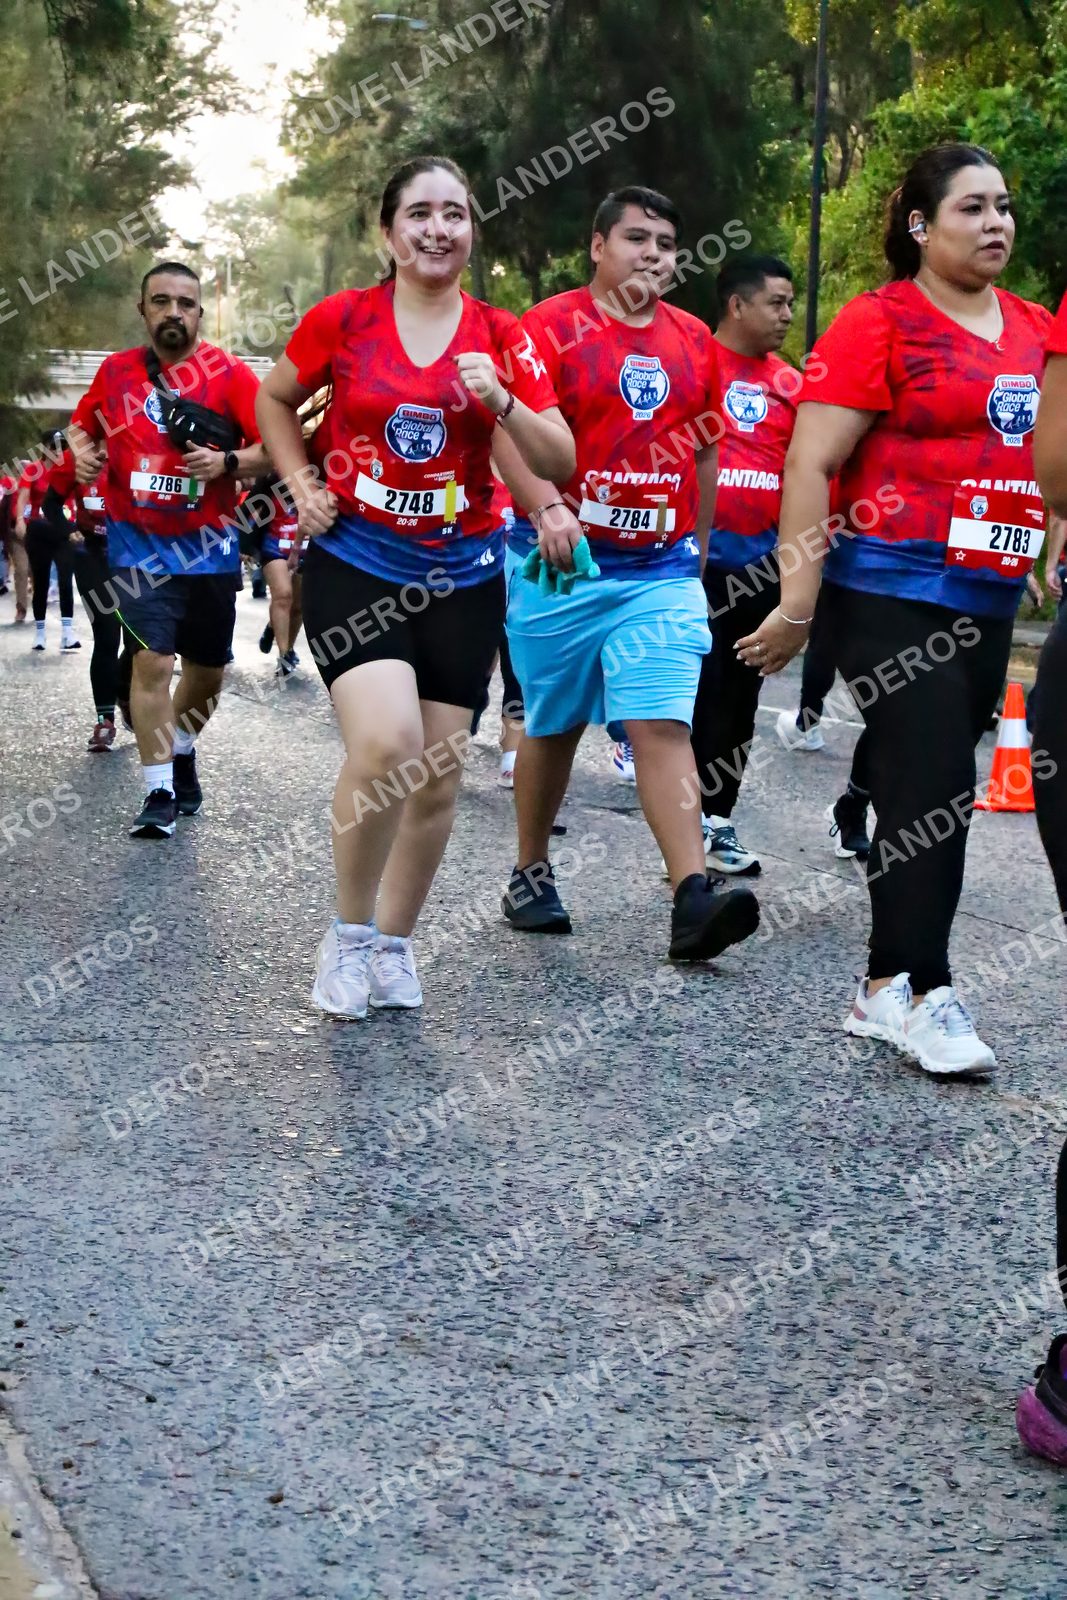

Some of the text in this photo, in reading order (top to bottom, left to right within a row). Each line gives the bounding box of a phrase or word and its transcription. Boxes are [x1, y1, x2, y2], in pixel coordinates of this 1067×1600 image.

[629, 360, 656, 369] BIMBO
[631, 370, 657, 380] Global
[627, 379, 647, 389] Race
[1001, 380, 1032, 388] BIMBO
[1002, 392, 1032, 403] Global
[996, 401, 1021, 412] Race
[402, 410, 438, 421] BIMBO
[401, 420, 434, 433] Global
[394, 428, 420, 440] Race
[150, 475, 182, 492] 2786
[717, 468, 779, 491] ANTIAGO
[384, 489, 434, 514] 2748
[396, 517, 418, 526] 20-26
[609, 508, 651, 529] 2784
[989, 524, 1031, 554] 2783
